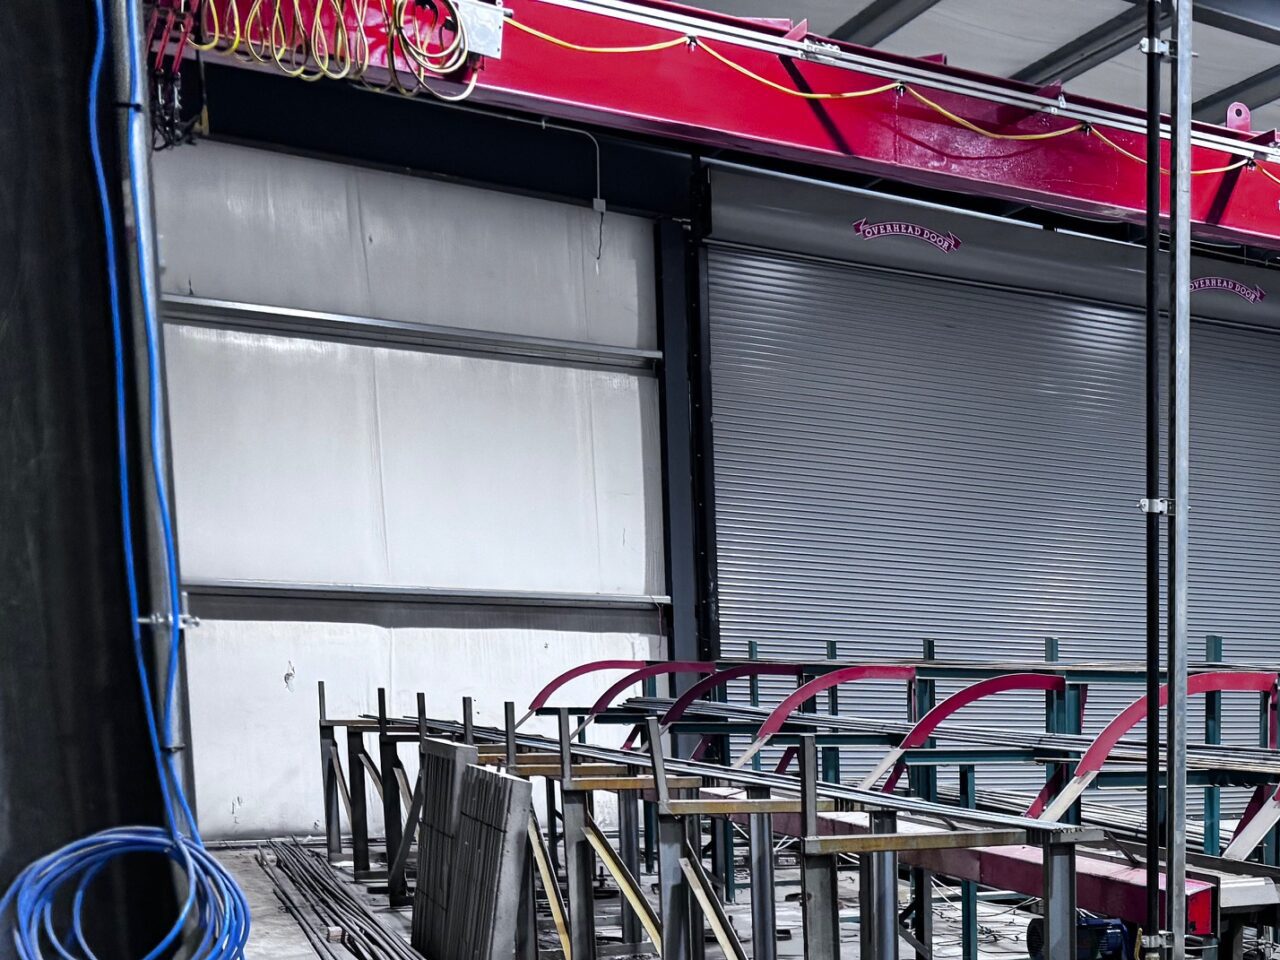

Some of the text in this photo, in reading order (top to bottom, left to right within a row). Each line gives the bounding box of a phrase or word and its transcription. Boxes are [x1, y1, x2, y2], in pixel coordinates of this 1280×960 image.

[864, 223, 951, 250] OVERHEAD DOOR
[1235, 284, 1256, 302] DOOR
